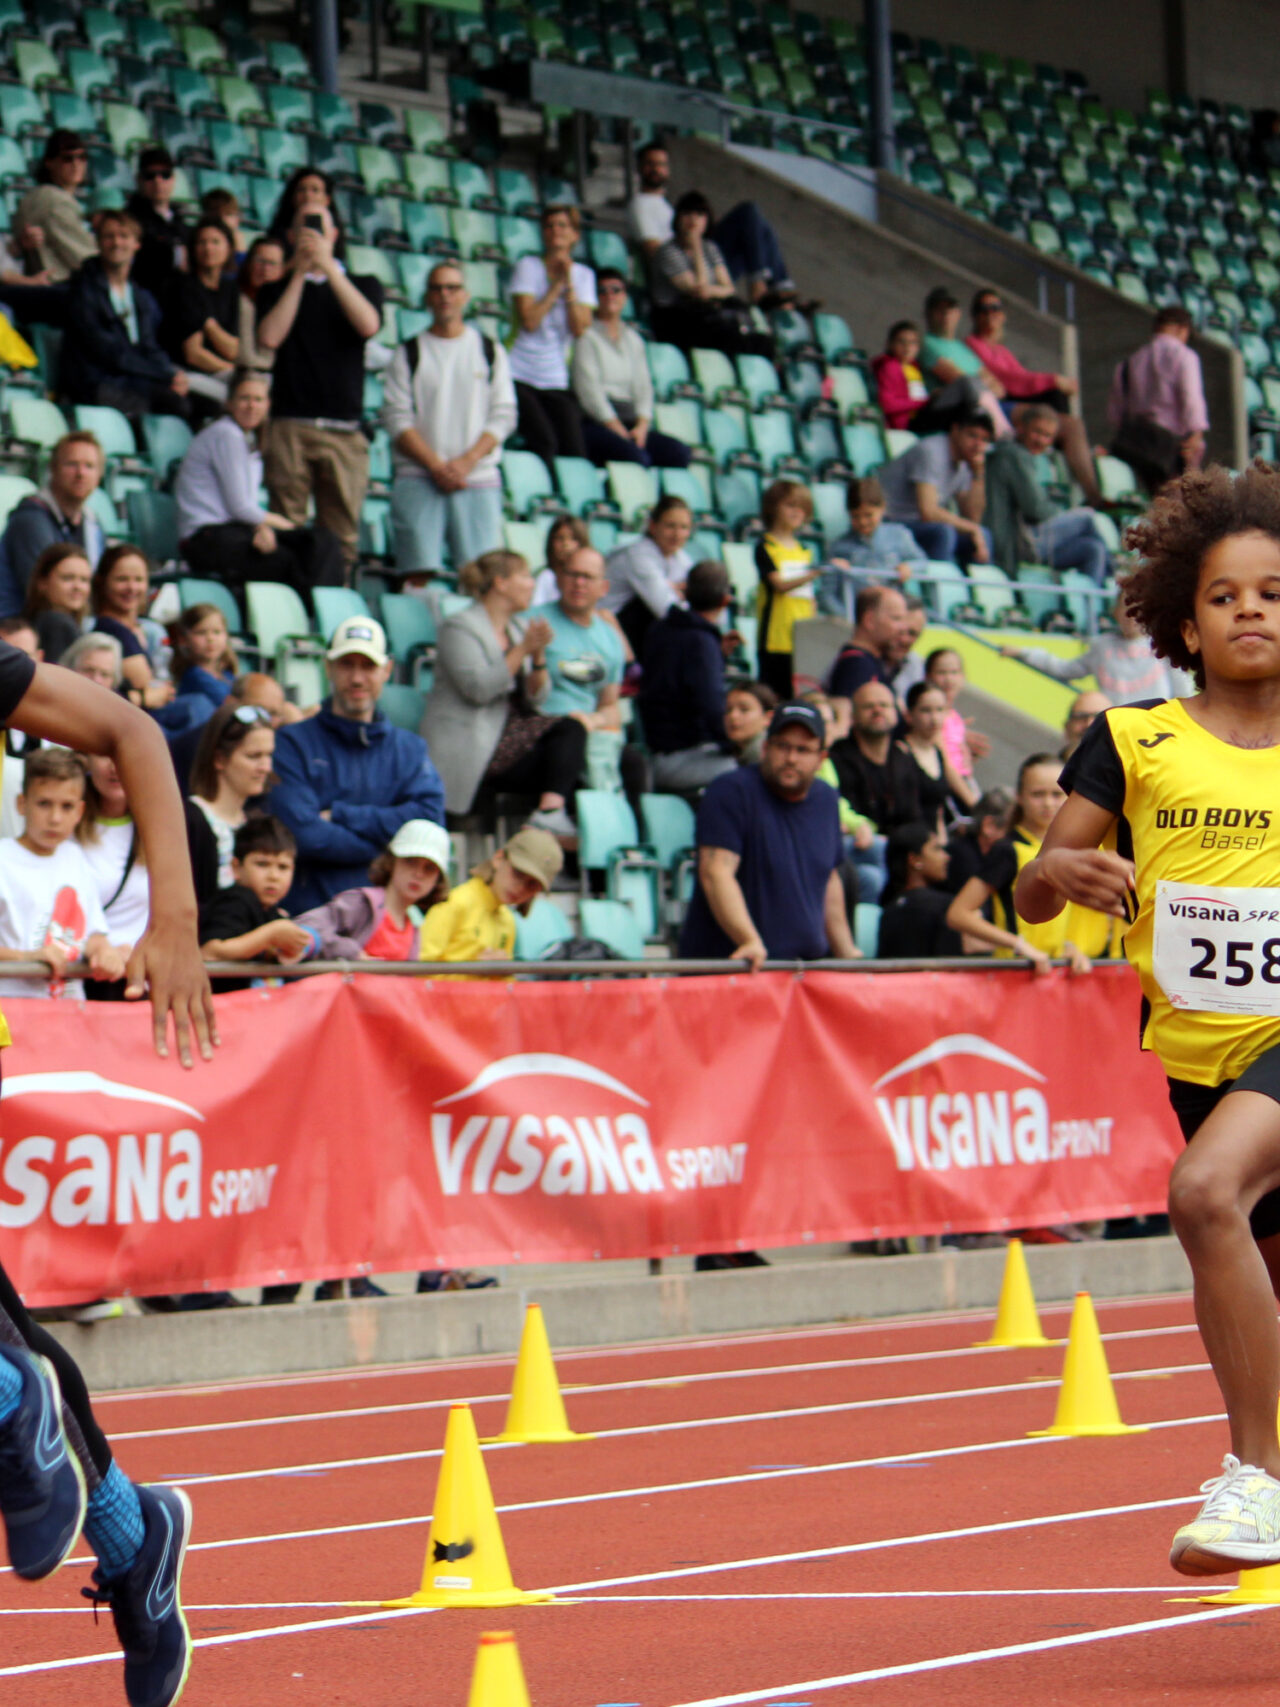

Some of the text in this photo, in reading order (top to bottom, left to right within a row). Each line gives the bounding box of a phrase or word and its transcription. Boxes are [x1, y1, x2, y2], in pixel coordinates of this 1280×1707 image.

[1156, 807, 1273, 829] OLD BOYS
[1200, 830, 1267, 851] Basel
[1189, 937, 1280, 987] 258
[666, 1143, 748, 1191] SPRINT
